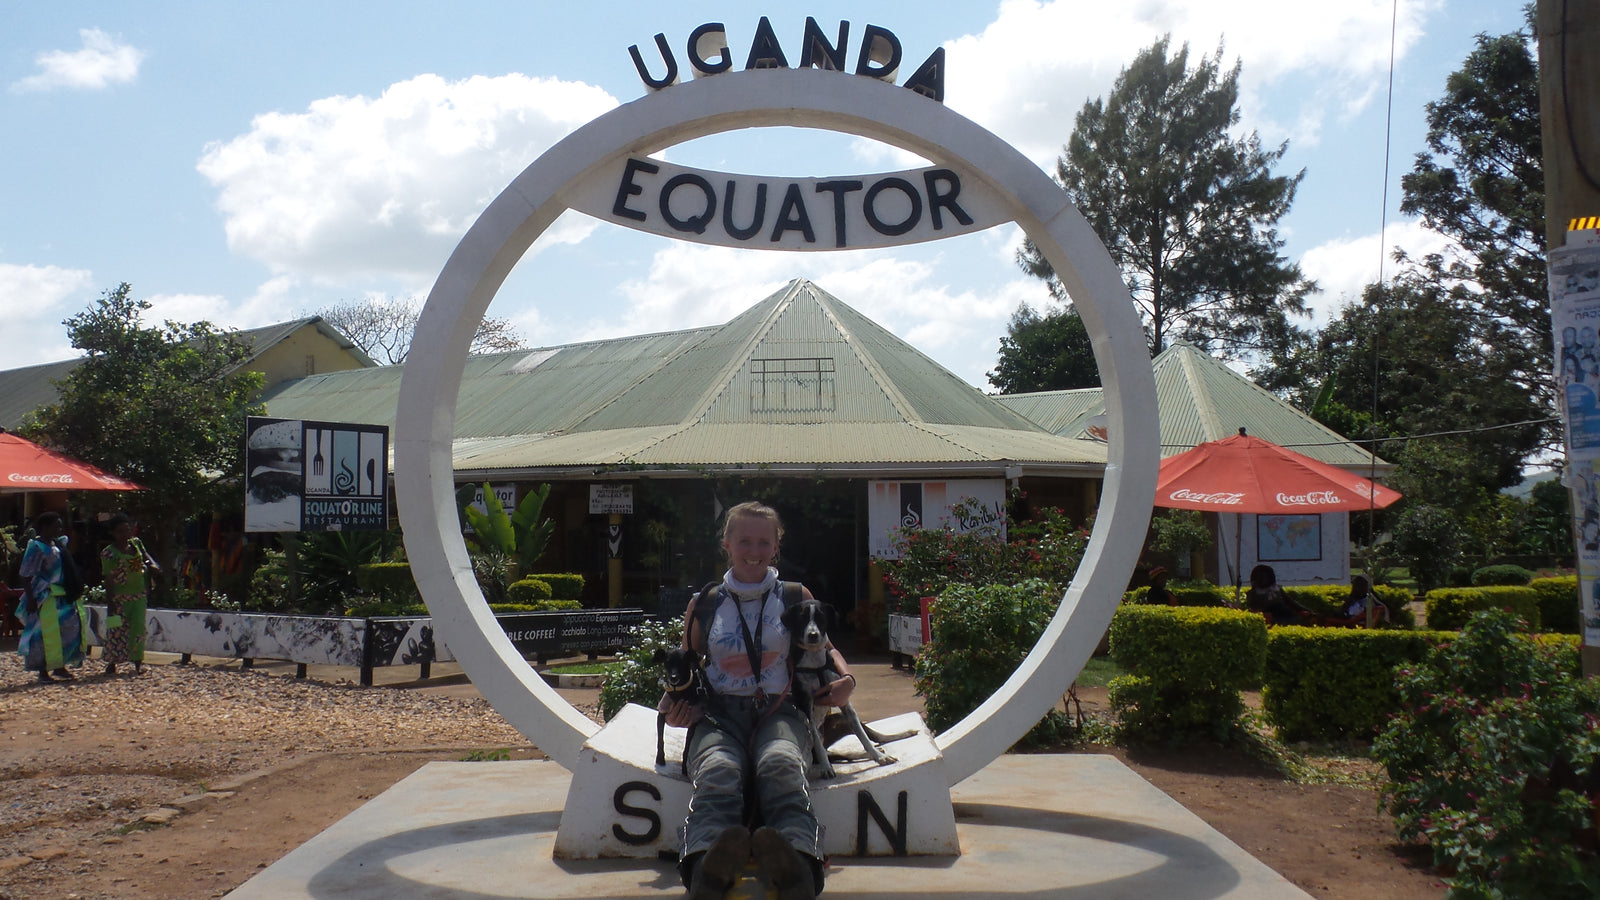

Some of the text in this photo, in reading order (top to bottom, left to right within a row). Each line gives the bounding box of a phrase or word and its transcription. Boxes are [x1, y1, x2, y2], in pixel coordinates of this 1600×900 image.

[628, 16, 946, 102] UGANDA
[612, 158, 974, 248] EQUATOR
[8, 473, 74, 484] Coca-Cola
[1169, 489, 1245, 505] Coca-Cola
[1276, 490, 1341, 506] Coca-Cola
[360, 502, 383, 515] LINE
[305, 517, 383, 525] RESTAURANT
[595, 613, 619, 624] Espresso
[524, 628, 556, 640] COFFEE!
[612, 781, 908, 857] S N
